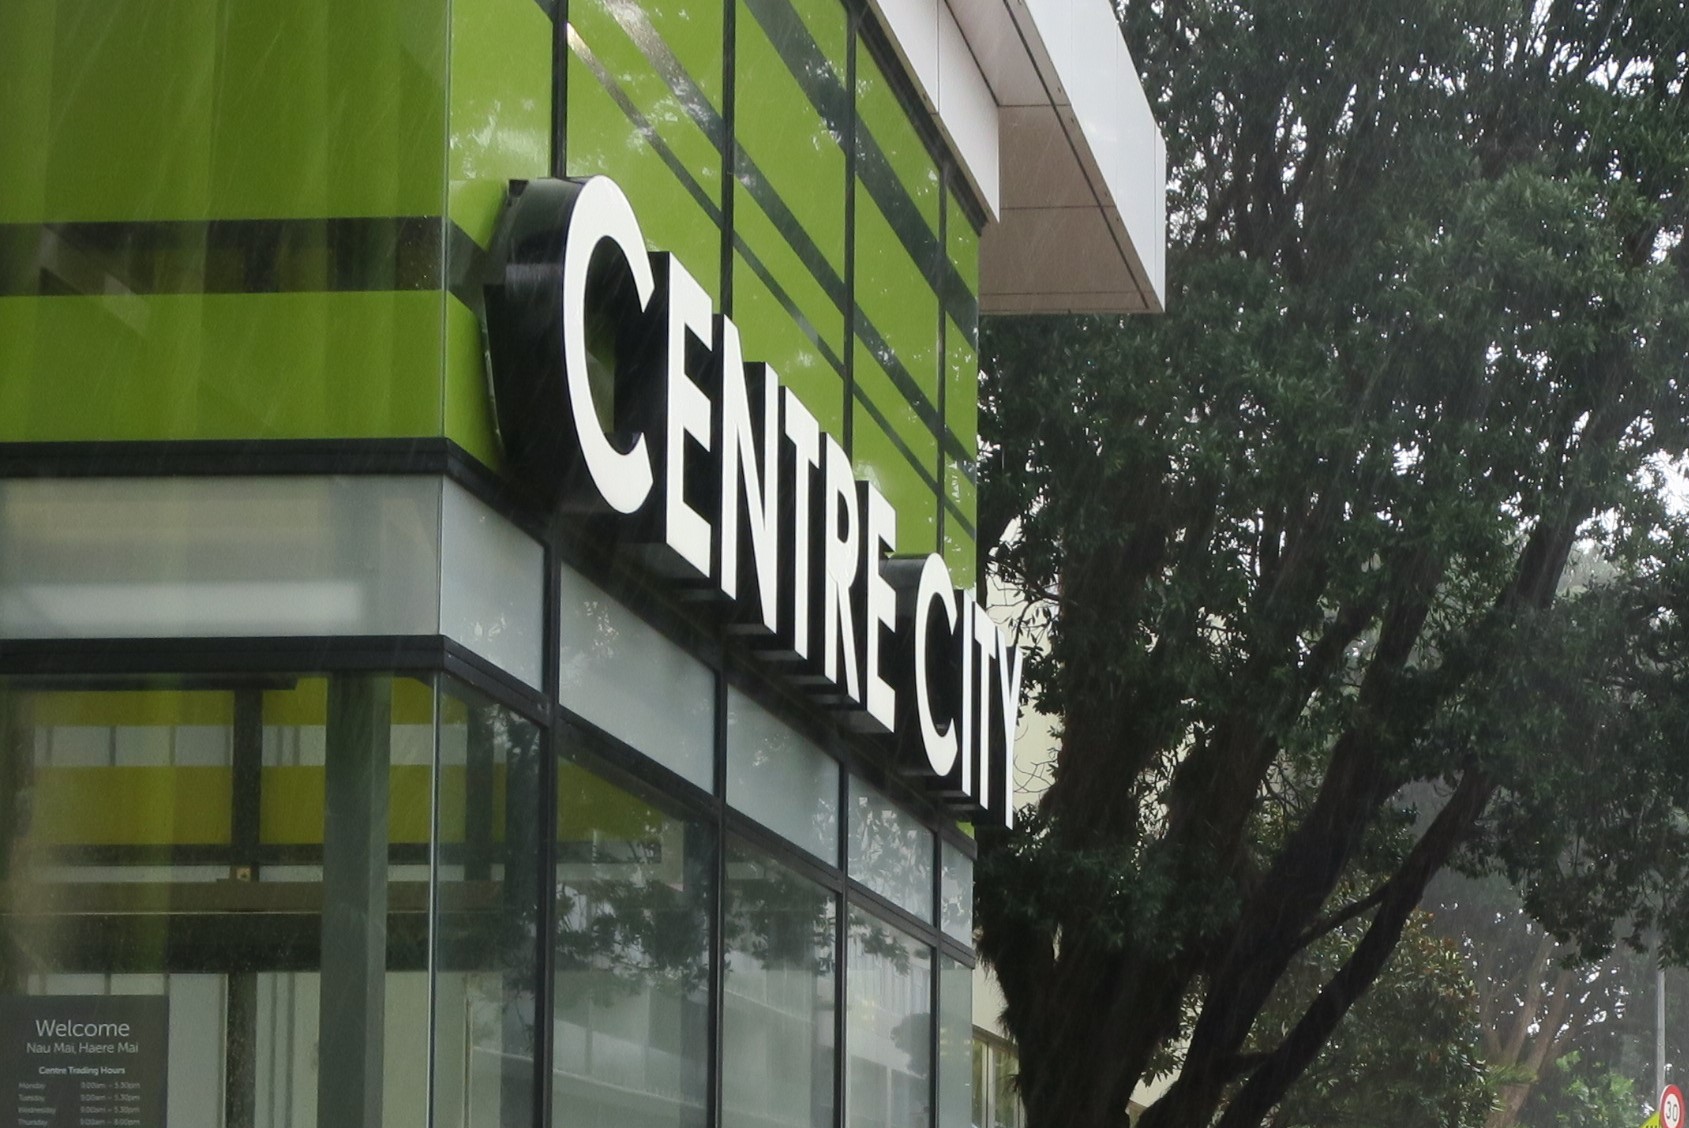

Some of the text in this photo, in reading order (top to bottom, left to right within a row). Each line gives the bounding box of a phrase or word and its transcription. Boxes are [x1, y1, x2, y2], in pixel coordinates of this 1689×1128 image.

[563, 174, 1024, 831] CENTRE CITY
[35, 1019, 130, 1037] Welcome
[26, 1042, 51, 1053] Nau
[79, 1042, 115, 1053] Haere
[117, 1042, 139, 1053] Mai
[38, 1066, 126, 1076] Centre Trading Hours
[1666, 1100, 1678, 1122] 30
